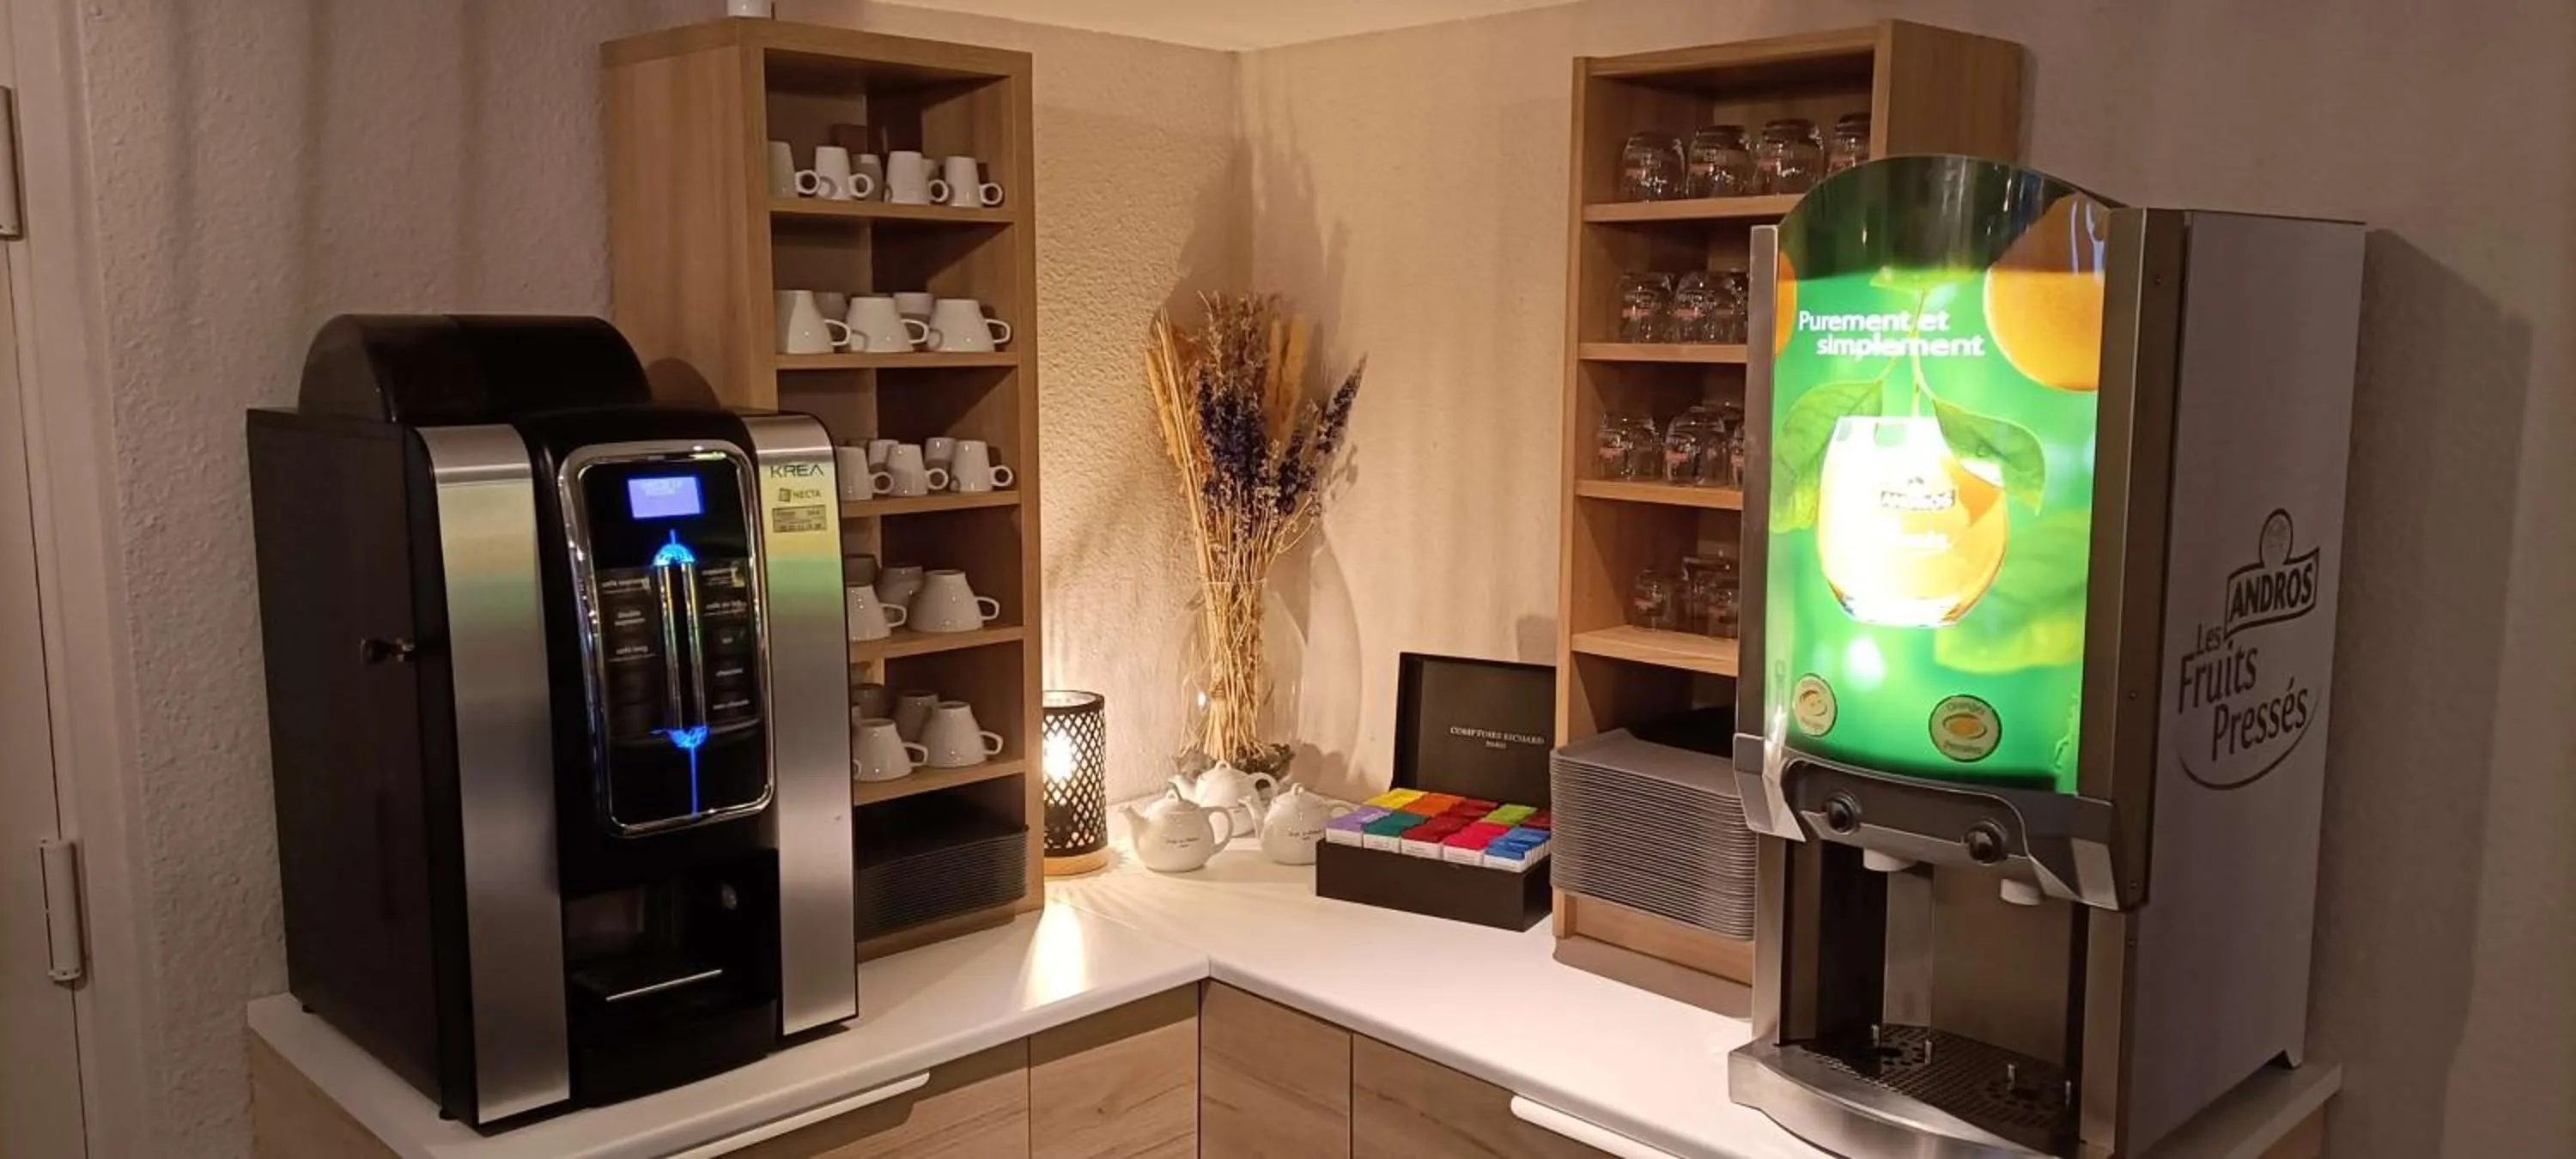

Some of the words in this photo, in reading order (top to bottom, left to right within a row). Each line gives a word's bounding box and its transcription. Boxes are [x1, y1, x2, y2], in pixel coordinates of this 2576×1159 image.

[1799, 310, 1911, 332] Purement
[1916, 310, 1950, 332] et
[1816, 334, 1985, 361] simplement
[770, 464, 824, 478] KREA
[2228, 562, 2313, 623] ANDROS
[2196, 622, 2222, 657] Les
[2178, 639, 2258, 715] Fruits
[2211, 676, 2309, 762] Pressés
